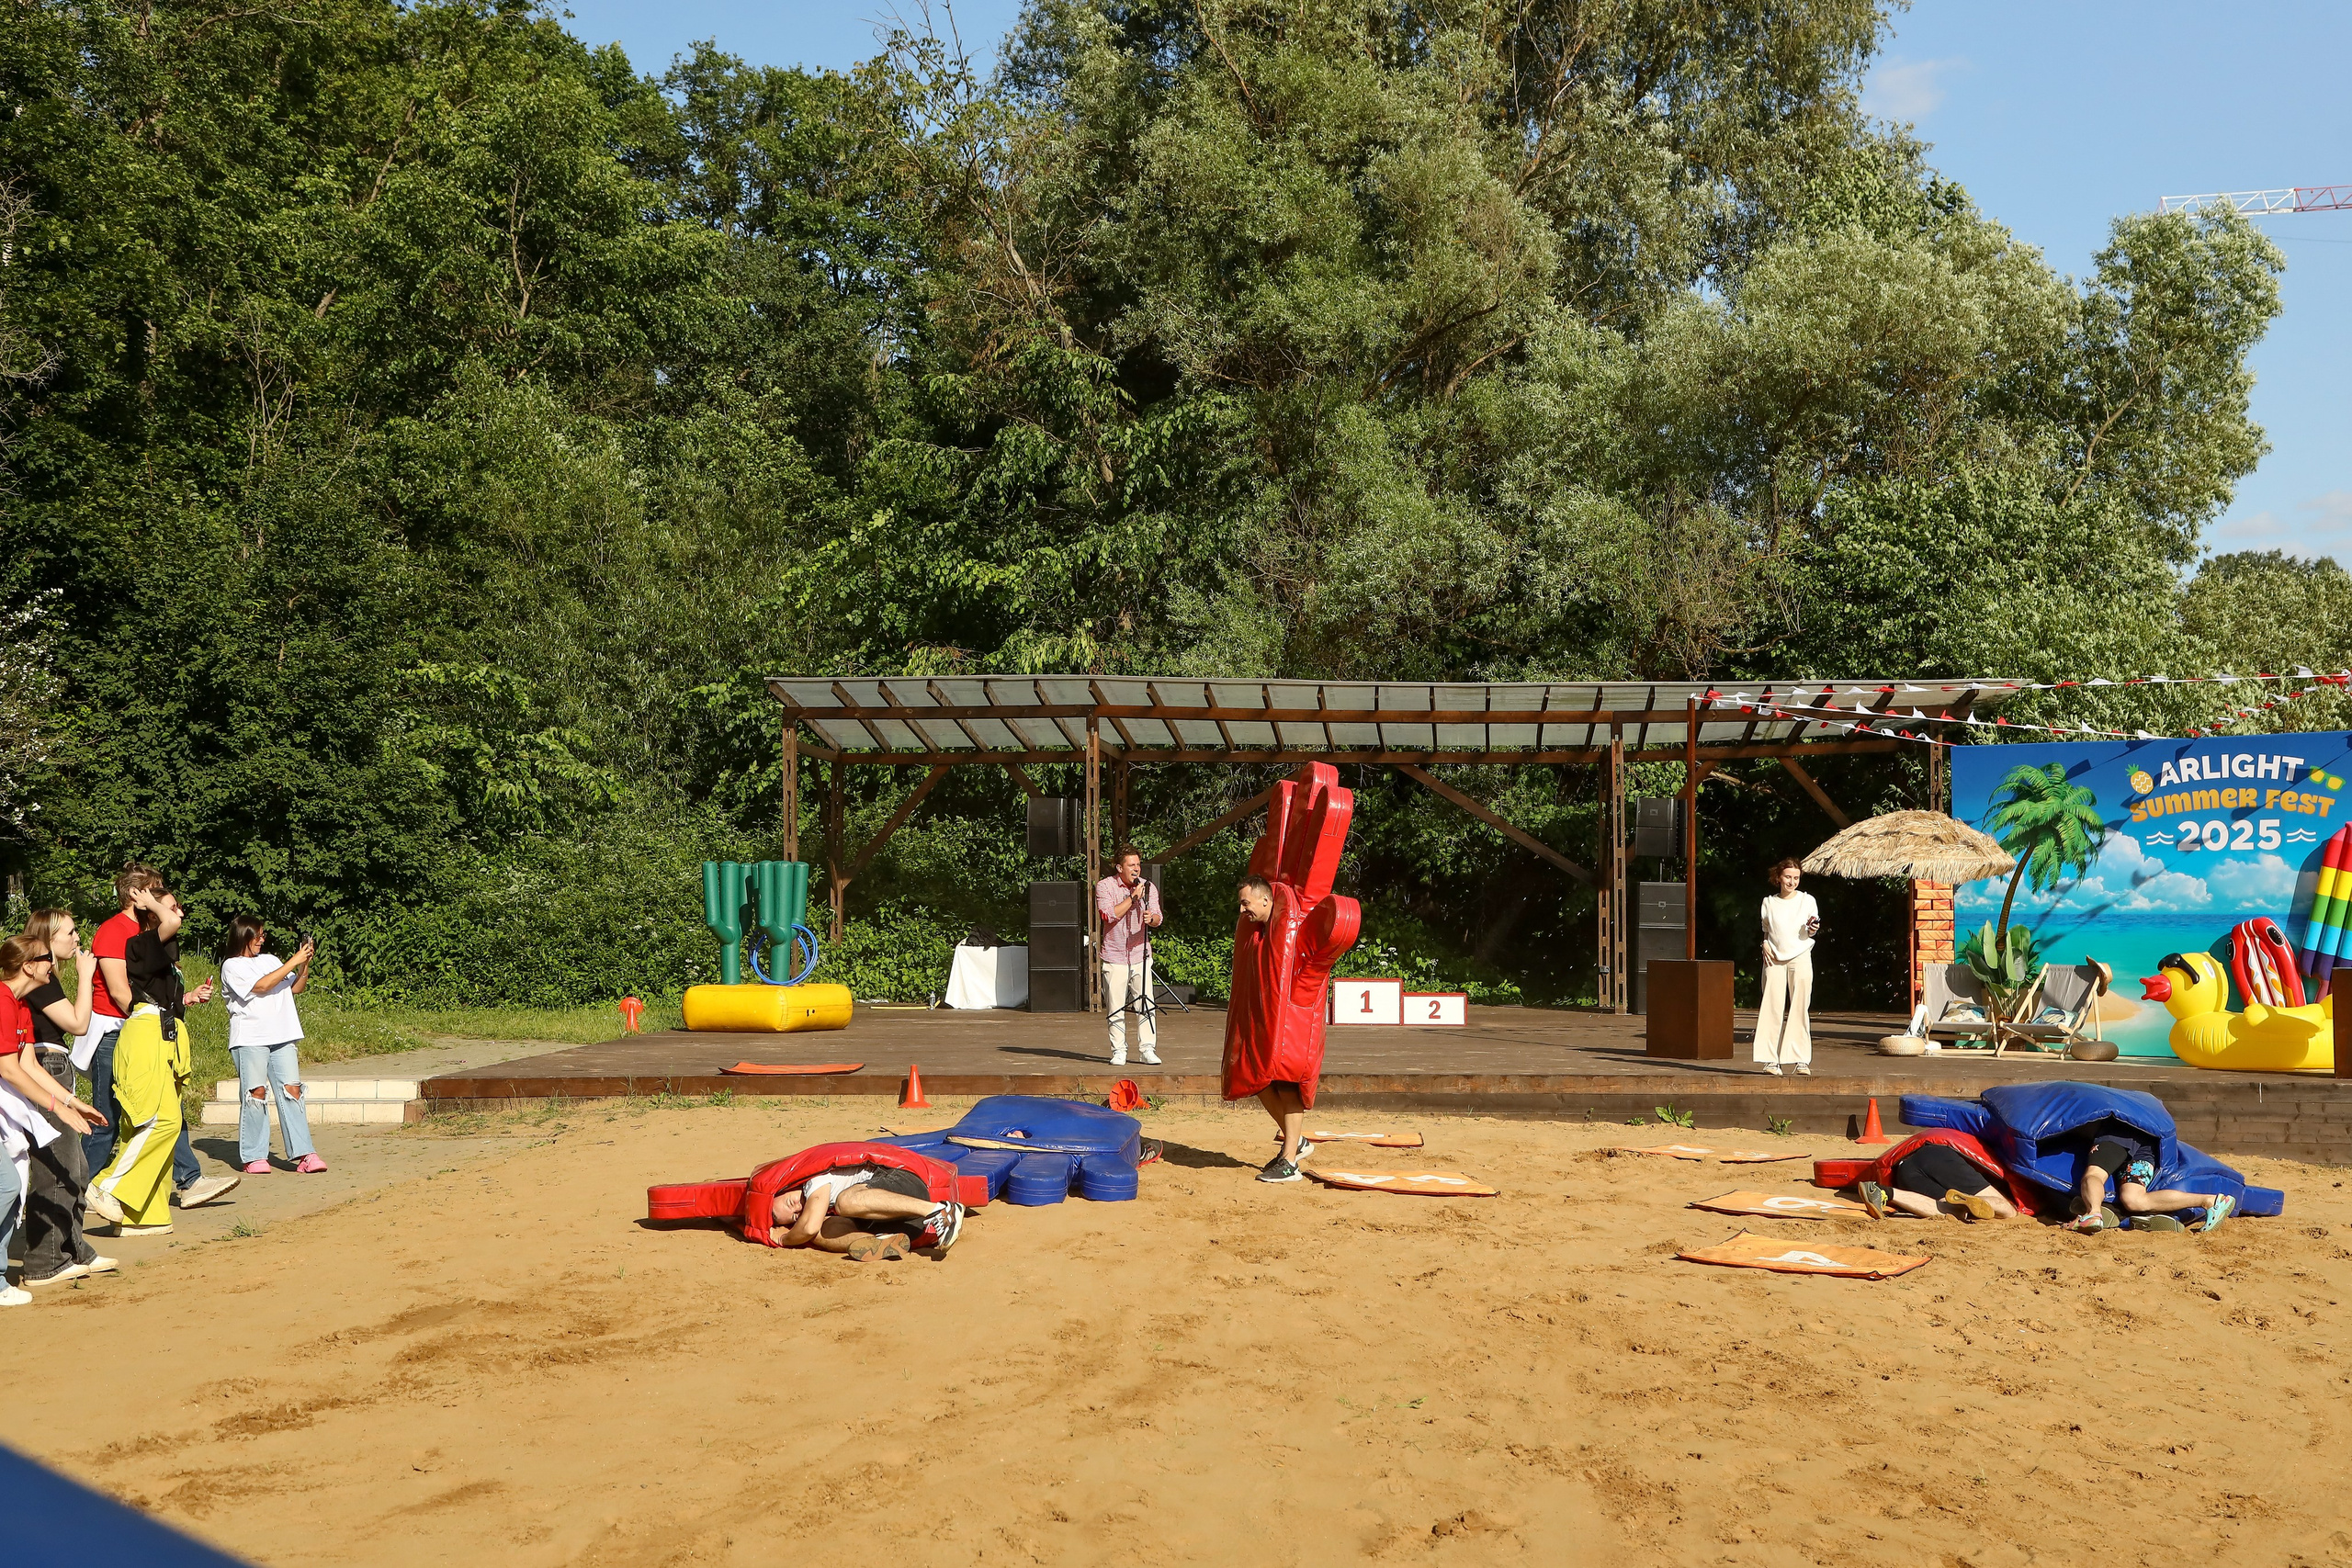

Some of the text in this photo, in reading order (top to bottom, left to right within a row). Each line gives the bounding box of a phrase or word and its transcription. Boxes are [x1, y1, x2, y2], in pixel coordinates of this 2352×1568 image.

[2160, 754, 2304, 786] ARLIGHT
[2177, 818, 2282, 852] 2025
[1360, 990, 1373, 1012] 1
[1428, 1000, 1441, 1019] 2
